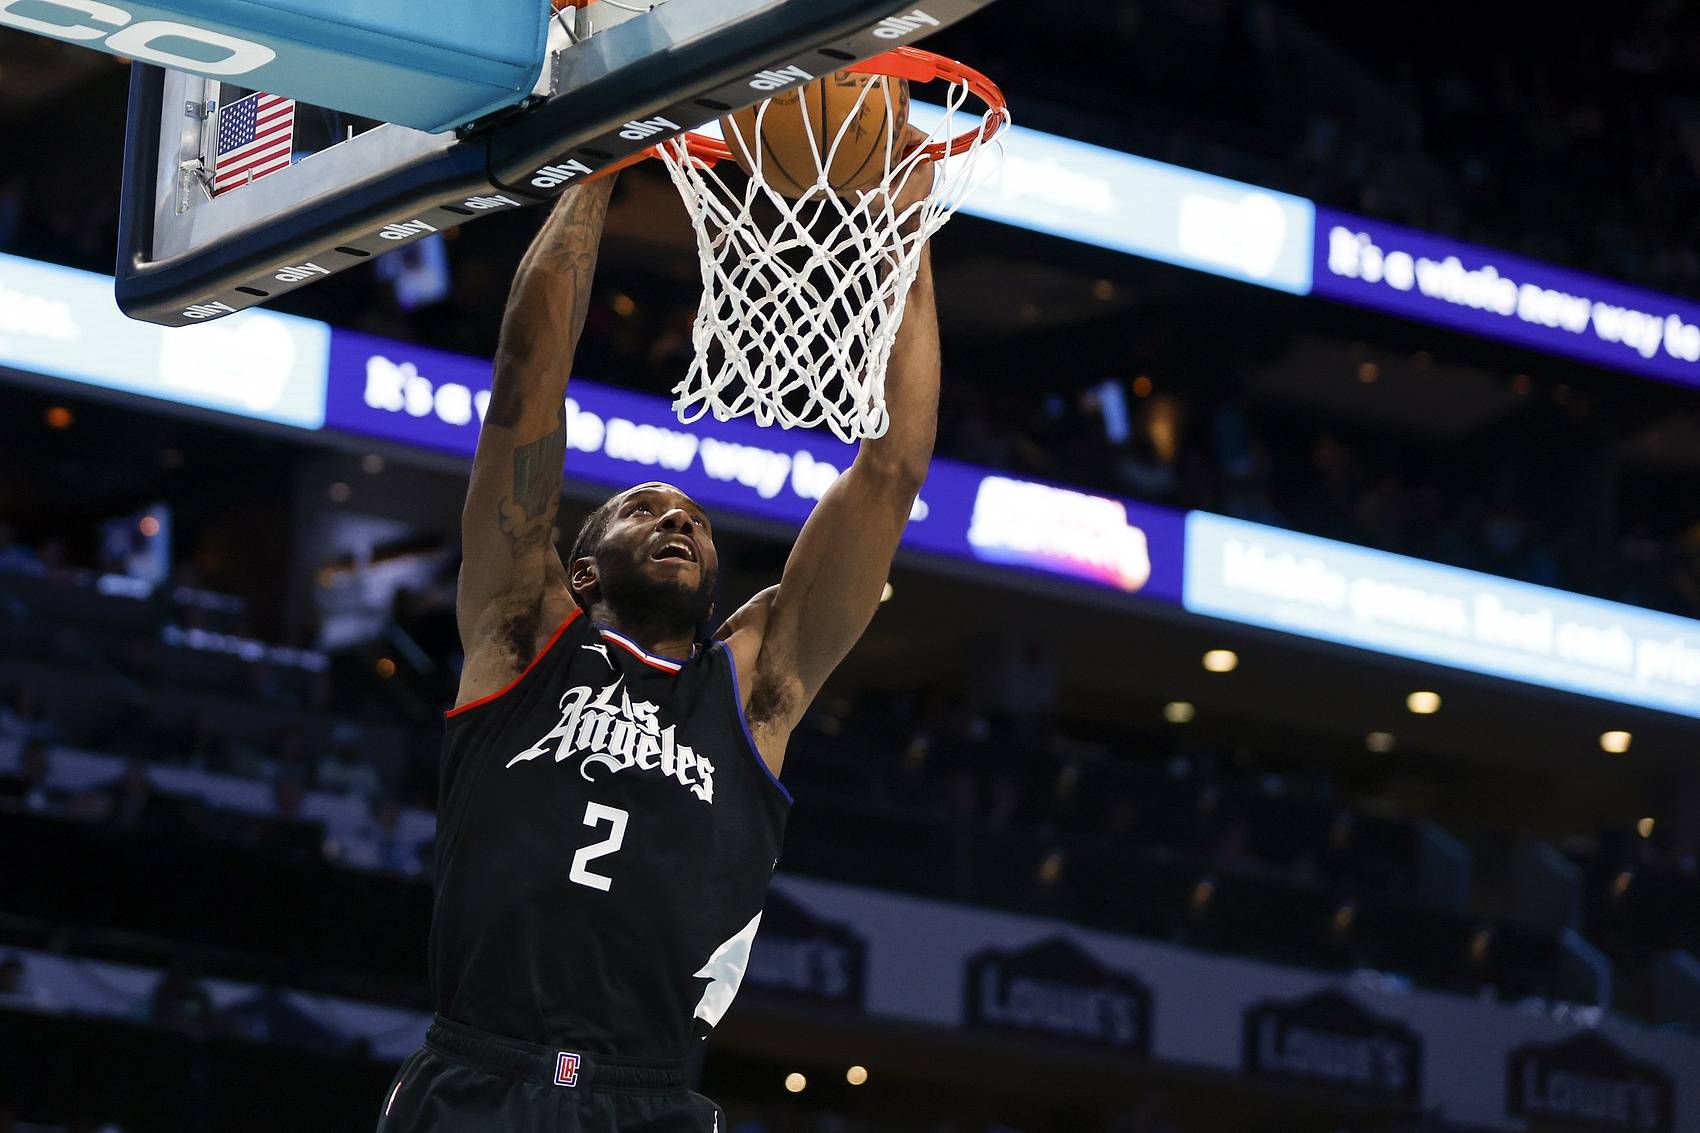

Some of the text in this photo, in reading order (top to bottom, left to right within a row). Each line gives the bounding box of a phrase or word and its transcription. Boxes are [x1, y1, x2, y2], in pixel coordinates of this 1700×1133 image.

[872, 8, 941, 41] ally
[749, 64, 814, 91] ally
[618, 114, 681, 142] ally
[530, 158, 594, 190] ally
[465, 194, 521, 211] ally
[379, 219, 438, 241] ally
[275, 262, 331, 283] ally
[182, 301, 235, 320] ally
[583, 672, 661, 737] Los
[506, 685, 715, 804] Angeles
[569, 801, 629, 891] 2
